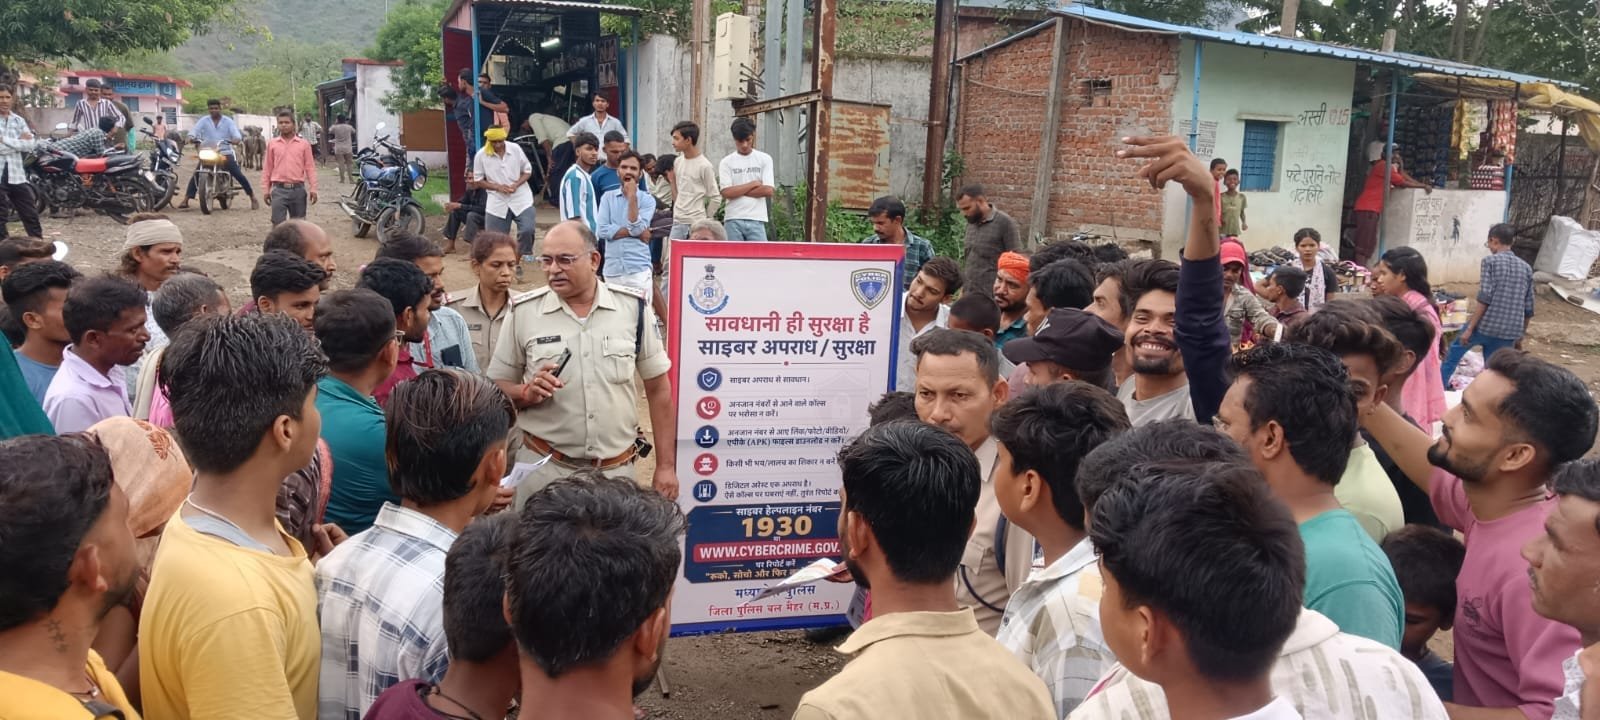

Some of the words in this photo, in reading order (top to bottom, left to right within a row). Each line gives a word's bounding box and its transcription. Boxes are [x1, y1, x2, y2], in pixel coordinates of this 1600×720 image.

[705, 311, 782, 332] सावधानी
[786, 311, 805, 332] ही
[808, 316, 854, 337] सुरक्षा
[858, 312, 871, 333] है
[698, 340, 757, 356] साइबर
[762, 340, 818, 356] अपराध
[820, 339, 829, 357] /
[832, 340, 876, 360] सुरक्षा
[730, 376, 750, 384] साइबर
[752, 376, 774, 384] अपराध
[776, 374, 781, 383] से
[729, 400, 753, 408] अनजान
[755, 398, 771, 408] नंबरों
[772, 399, 778, 407] से
[780, 399, 793, 407] आने
[808, 398, 826, 407] कॉल्स
[739, 409, 757, 417] भरोसा
[754, 428, 767, 436] नंबर
[769, 427, 775, 435] से
[727, 438, 745, 446] एपीके
[747, 438, 770, 446] (APK)
[726, 458, 743, 467] किसी
[745, 458, 752, 467] भी
[754, 459, 786, 467] भय/लालच
[798, 458, 818, 466] शिकार
[725, 481, 749, 489] डिजिटल
[725, 490, 734, 499] ऐसे
[736, 490, 753, 498] कॉल्स
[800, 490, 813, 498] तुरंत
[815, 488, 832, 496] रिपोर्ट
[736, 508, 762, 516] साइबर
[765, 505, 803, 516] हेल्पलाइन
[805, 504, 822, 513] नंबर
[742, 515, 812, 538] 1930
[700, 542, 840, 559] WWW.CYBERCRIME.GOV.
[766, 560, 784, 568] रिपोर्ट
[786, 558, 796, 567] करें
[734, 570, 752, 579] सोचो
[772, 568, 787, 577] फिर
[709, 605, 732, 616] जिला
[737, 603, 763, 617] पुलिस
[767, 603, 781, 612] बल
